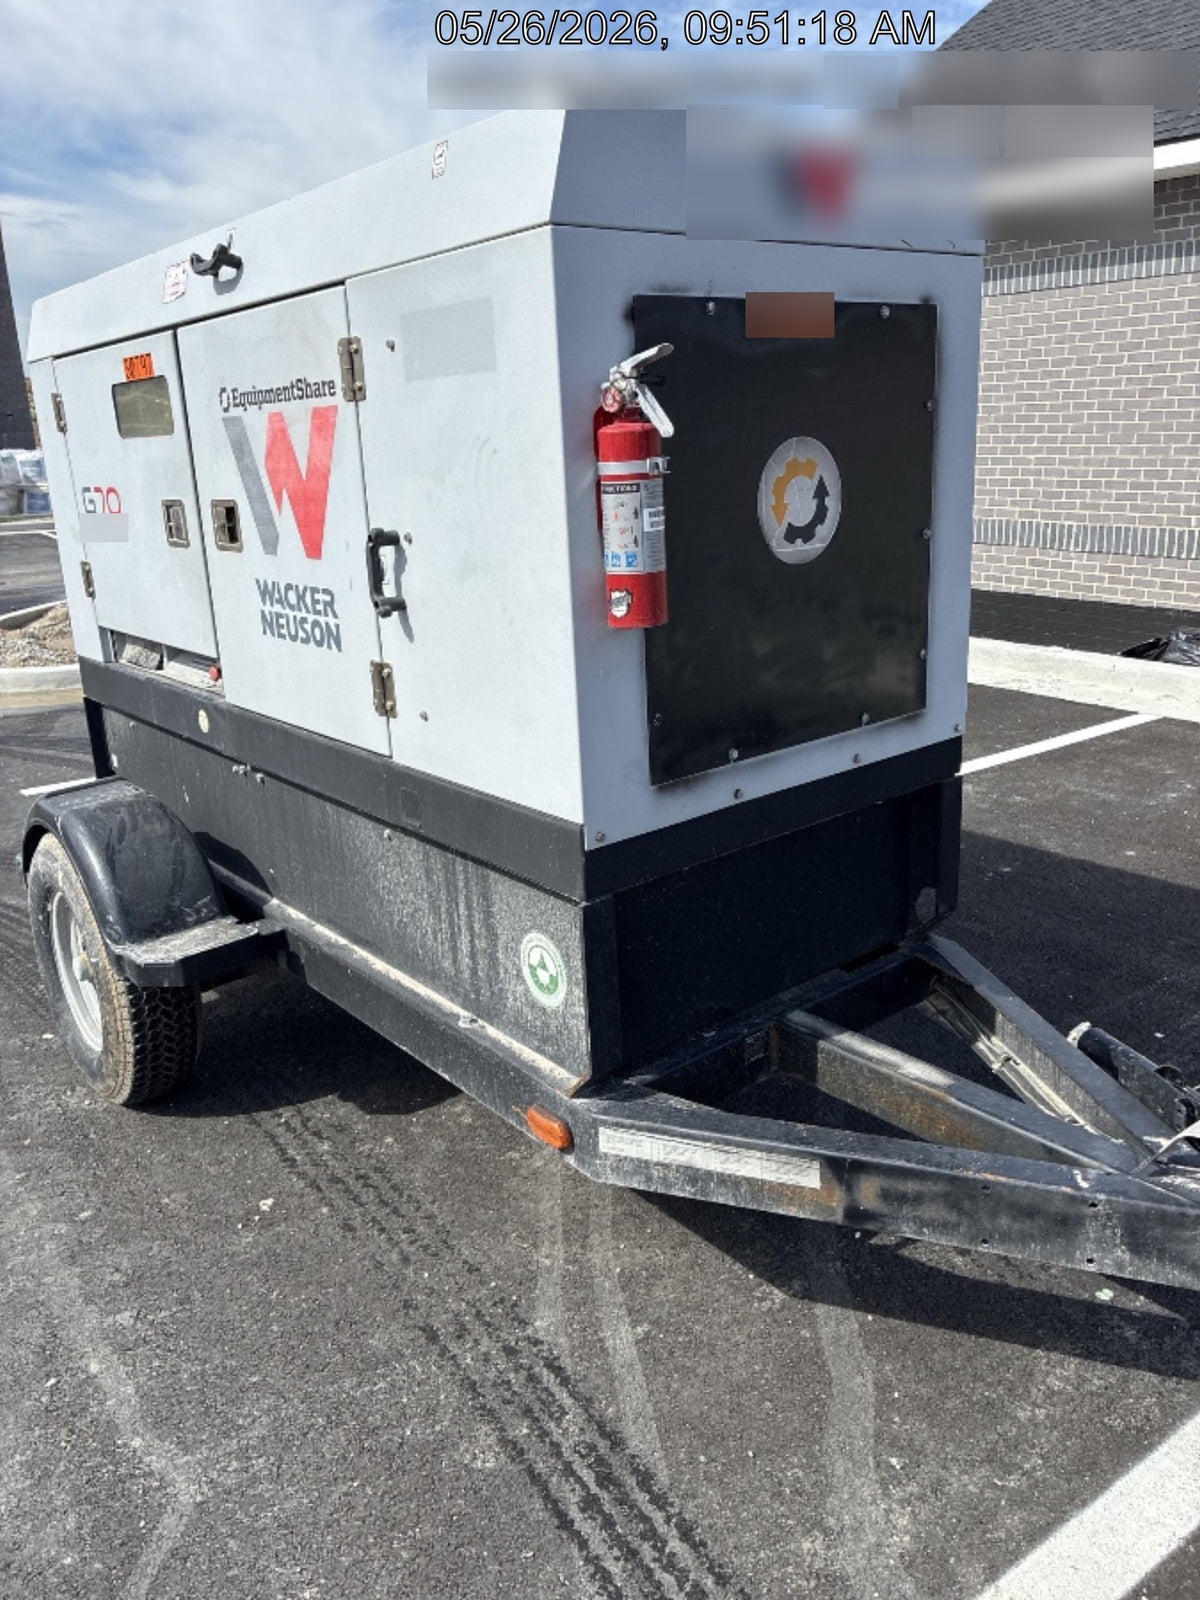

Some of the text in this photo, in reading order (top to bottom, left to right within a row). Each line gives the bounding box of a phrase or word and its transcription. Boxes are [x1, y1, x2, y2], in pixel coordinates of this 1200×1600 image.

[231, 377, 337, 412] EquipmentShare
[82, 486, 121, 513] G70
[255, 577, 339, 619] WACKER
[260, 609, 342, 652] NEUSON
